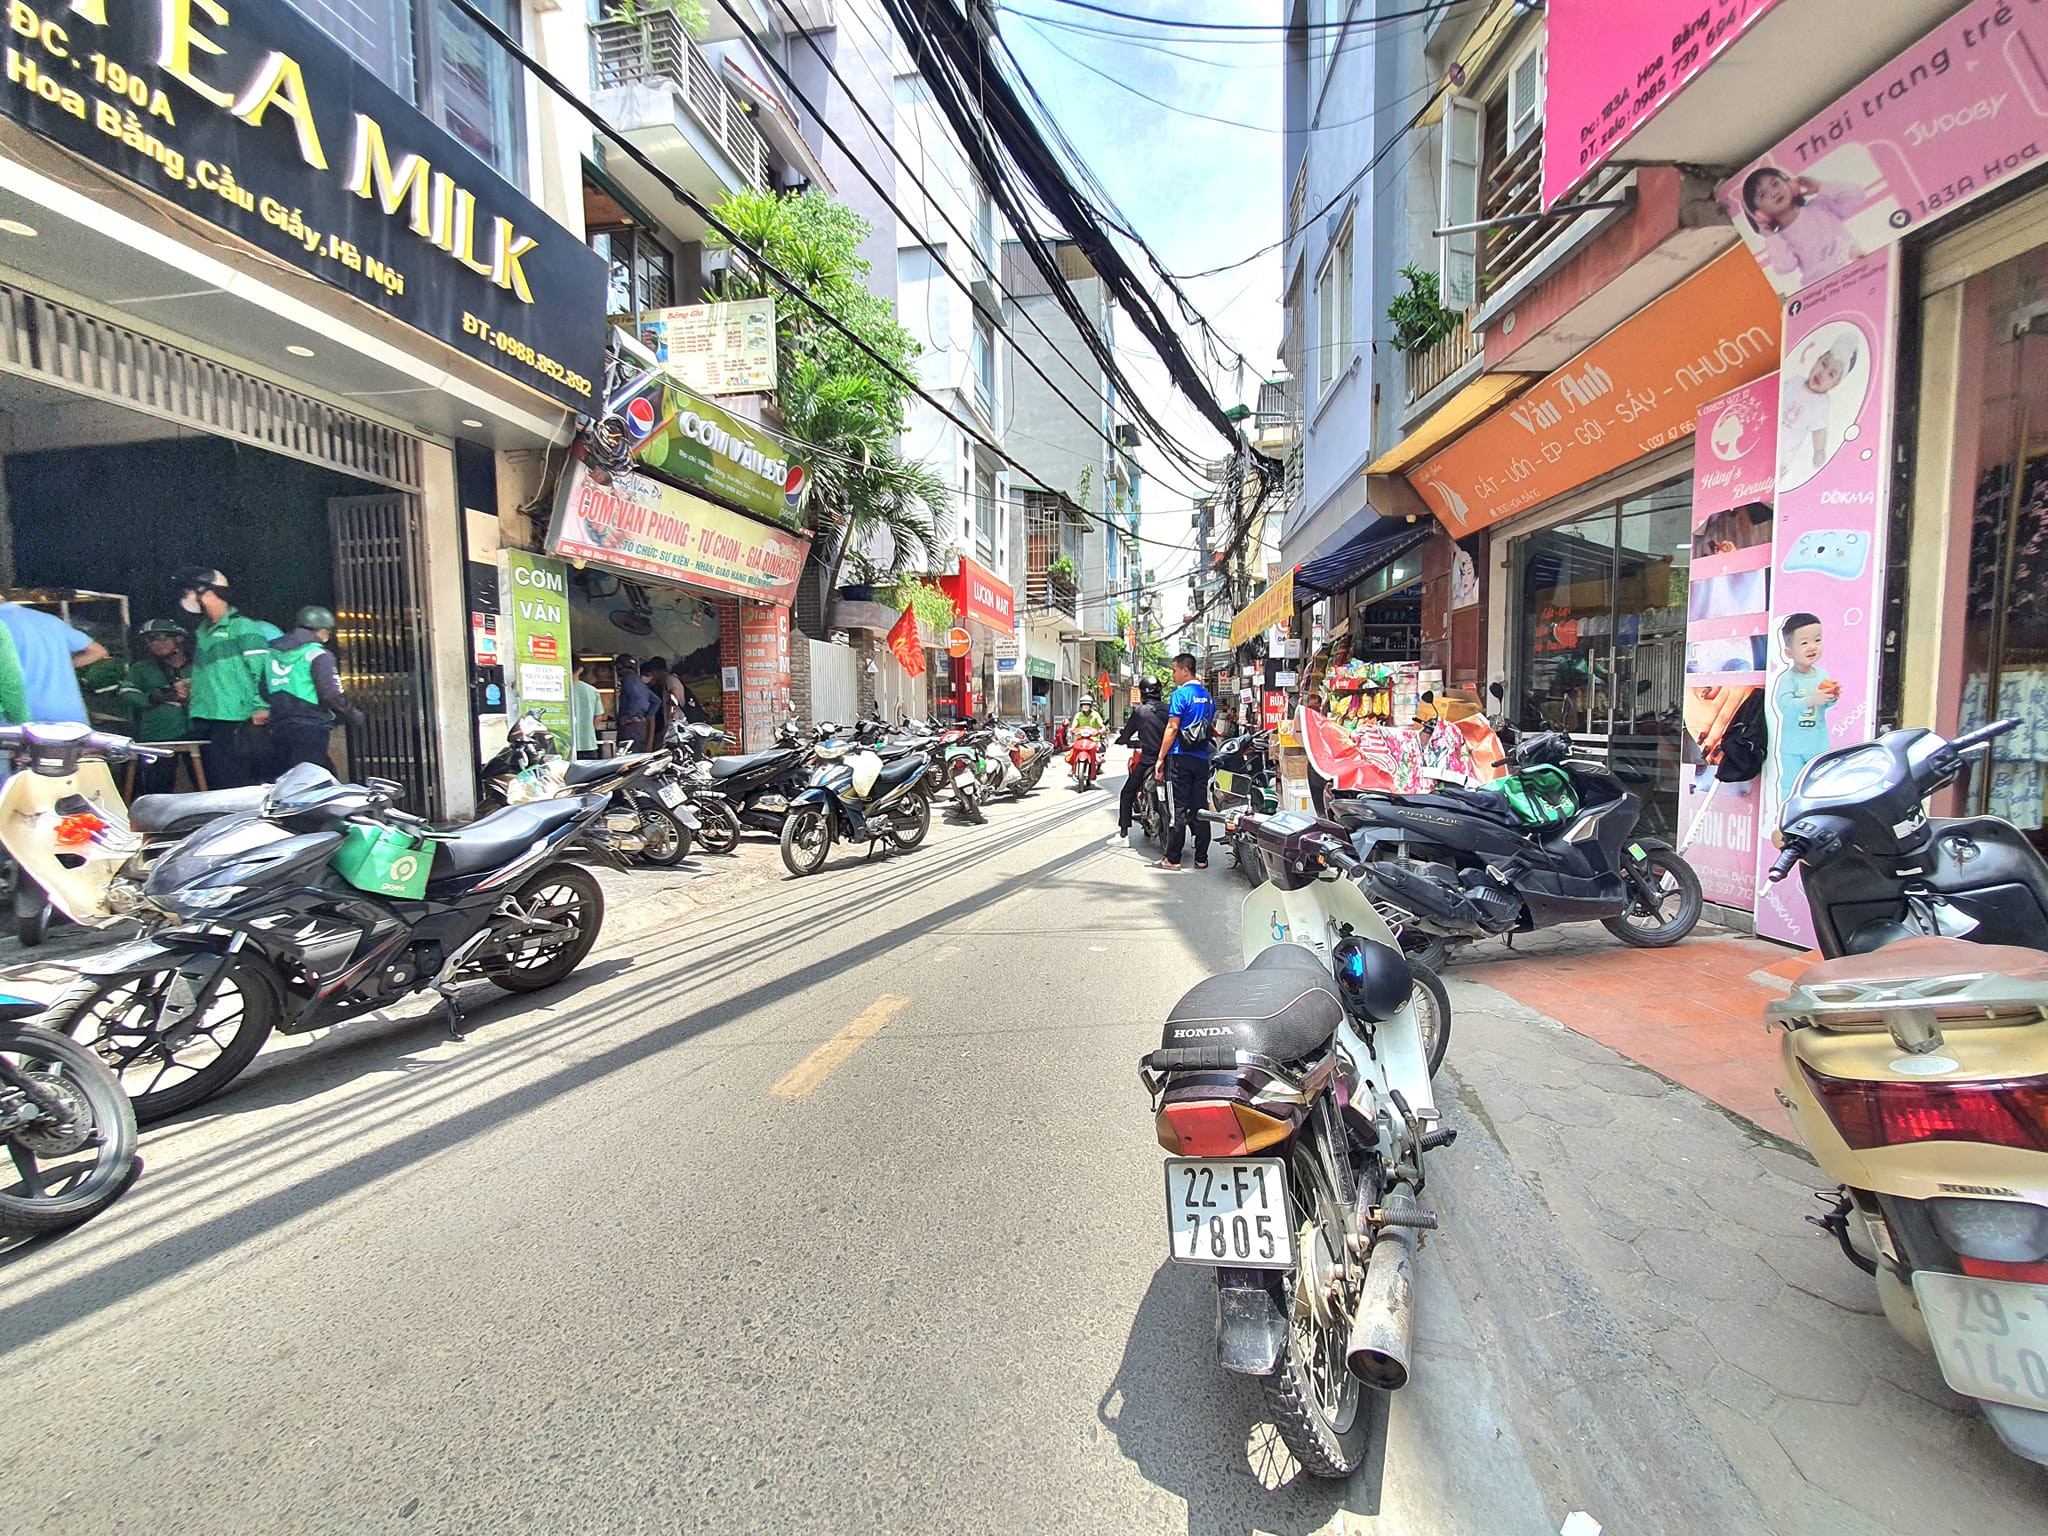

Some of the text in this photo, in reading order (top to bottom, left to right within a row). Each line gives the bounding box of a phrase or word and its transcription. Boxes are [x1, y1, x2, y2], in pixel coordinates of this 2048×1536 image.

[1632, 72, 1667, 116] 0985
[1672, 42, 1699, 80] 739
[1636, 54, 1664, 89] Hoa
[1794, 0, 2014, 161] Thời trang trẻ
[1904, 93, 2008, 146] JUDOBY
[6, 47, 87, 120] Hoa
[365, 255, 405, 296] Nội
[69, 0, 539, 304] EA MILK
[1918, 143, 2039, 214] 183A Hoa
[1508, 361, 1614, 436] Vân Anh
[1540, 441, 1563, 464] ÉP
[1674, 326, 1775, 393] NHUỘM
[577, 486, 617, 526] CƠM
[646, 510, 690, 548] PHÒNG
[713, 532, 742, 566] CHỌN
[514, 566, 563, 592] CƠM
[519, 598, 561, 624] VĂN
[380, 882, 407, 894] gojek
[1173, 1025, 1234, 1039] HONDA
[1937, 1182, 2022, 1197] HONDA
[1186, 1215, 1275, 1259] 7805
